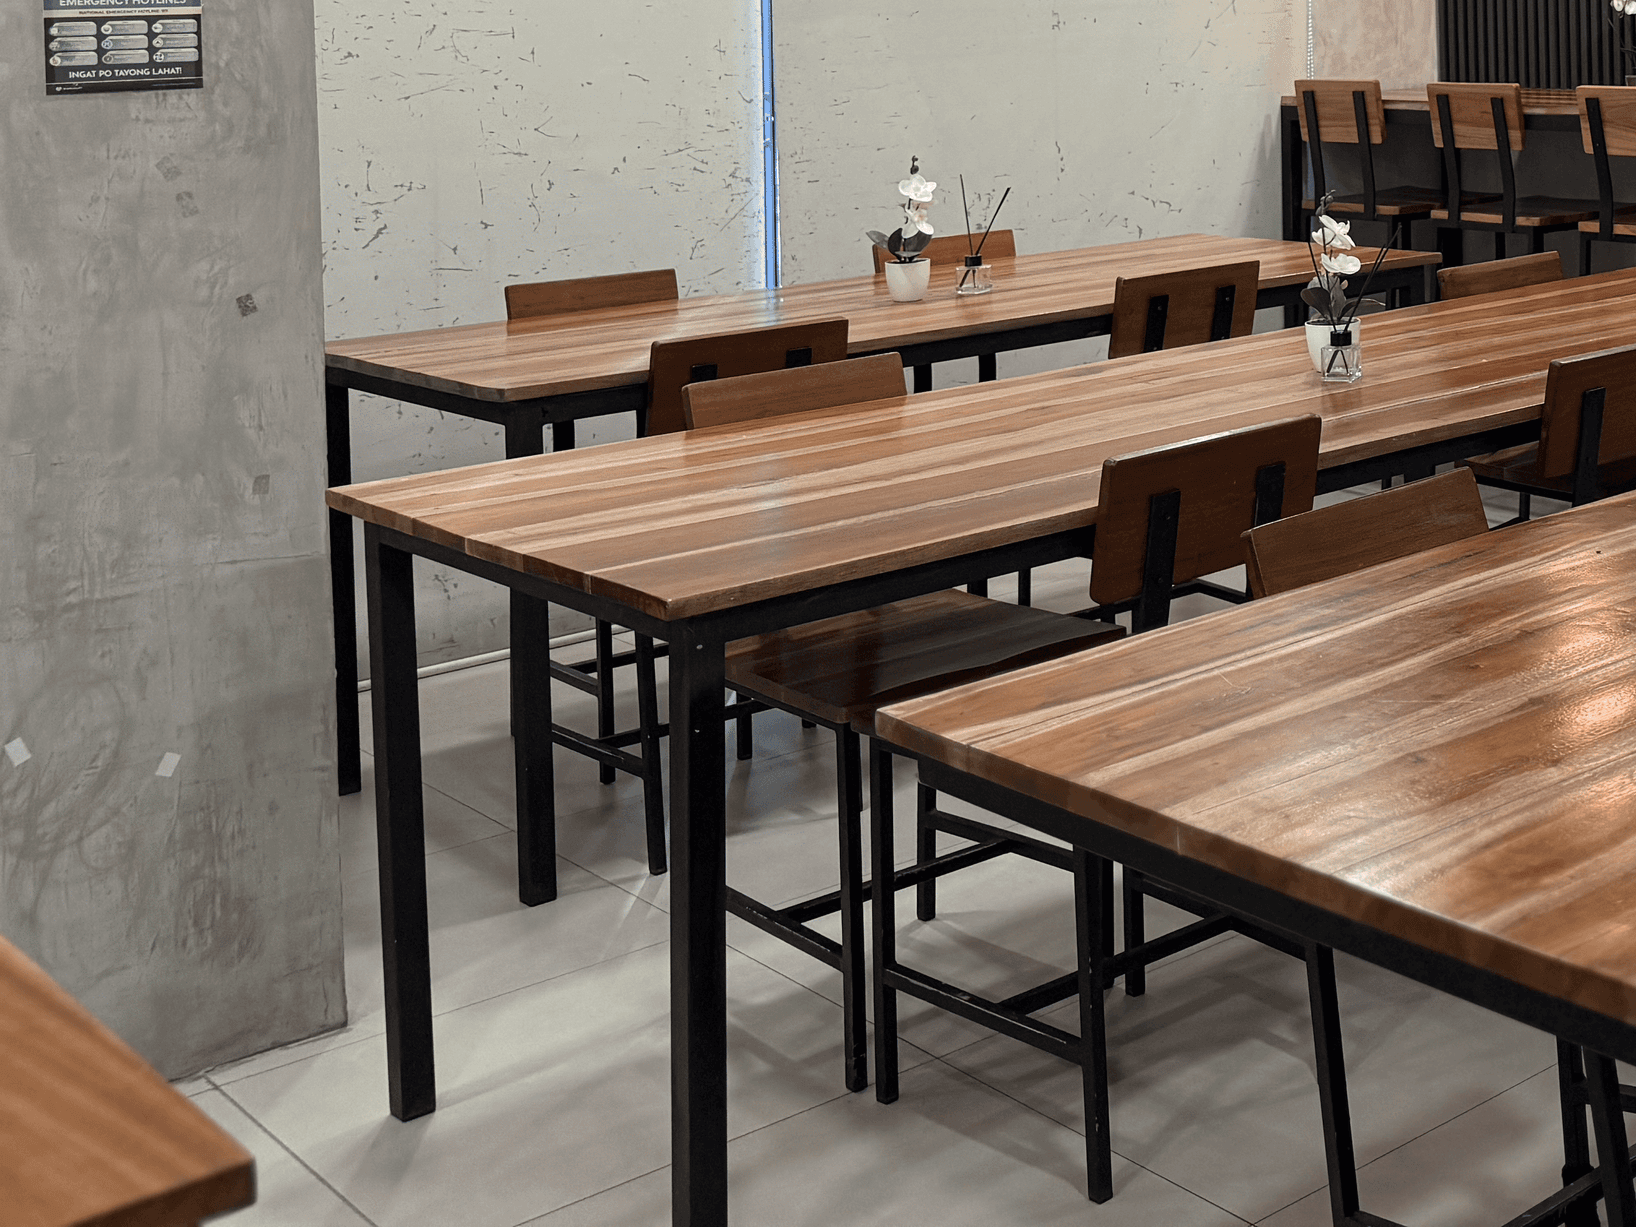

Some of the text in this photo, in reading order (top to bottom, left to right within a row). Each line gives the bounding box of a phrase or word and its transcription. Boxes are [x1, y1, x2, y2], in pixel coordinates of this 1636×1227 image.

[68, 67, 183, 79] INGAT PO TAYONG LAHAT!
